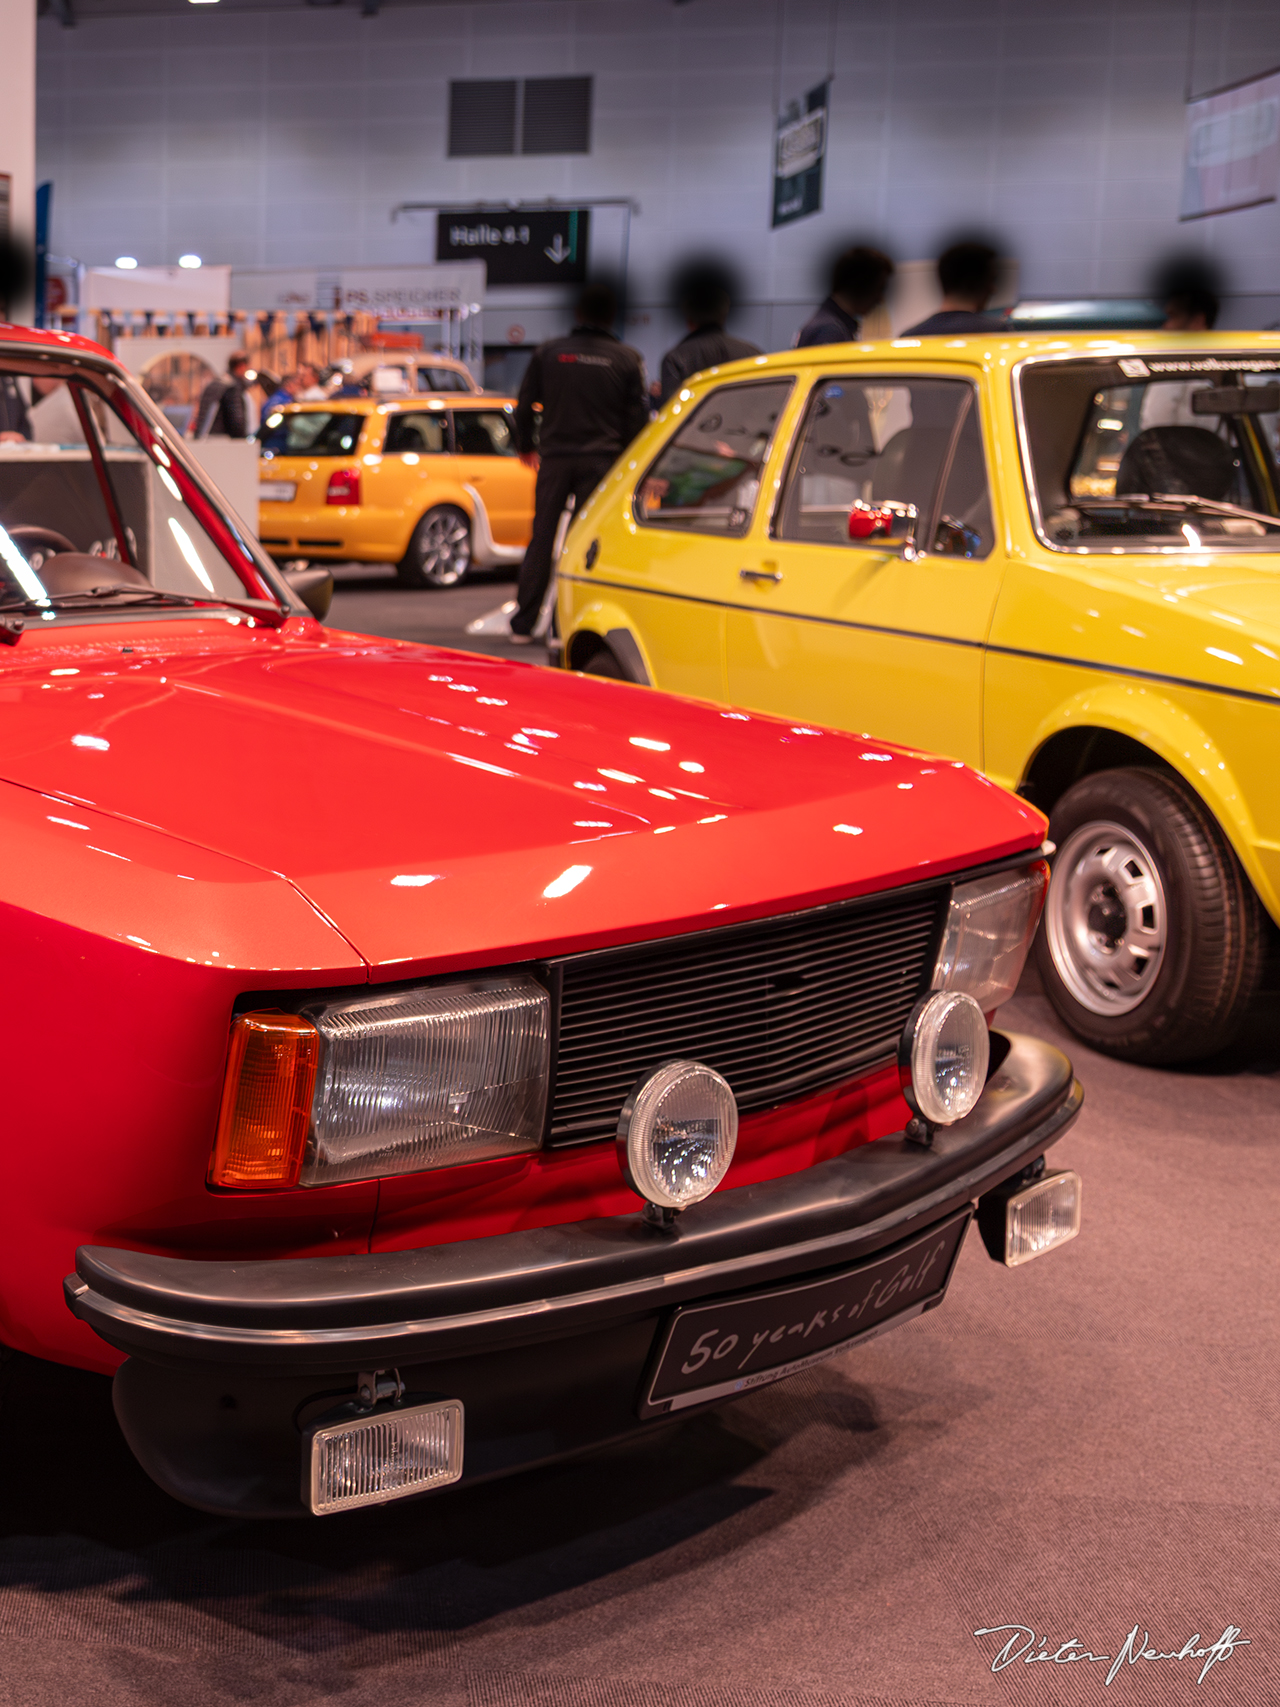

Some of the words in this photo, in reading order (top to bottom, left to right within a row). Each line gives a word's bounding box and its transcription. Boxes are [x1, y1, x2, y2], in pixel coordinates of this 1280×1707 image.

[450, 224, 501, 246] Halle
[681, 1329, 739, 1374] 50
[848, 1279, 881, 1319] of
[875, 1240, 946, 1310] Golf
